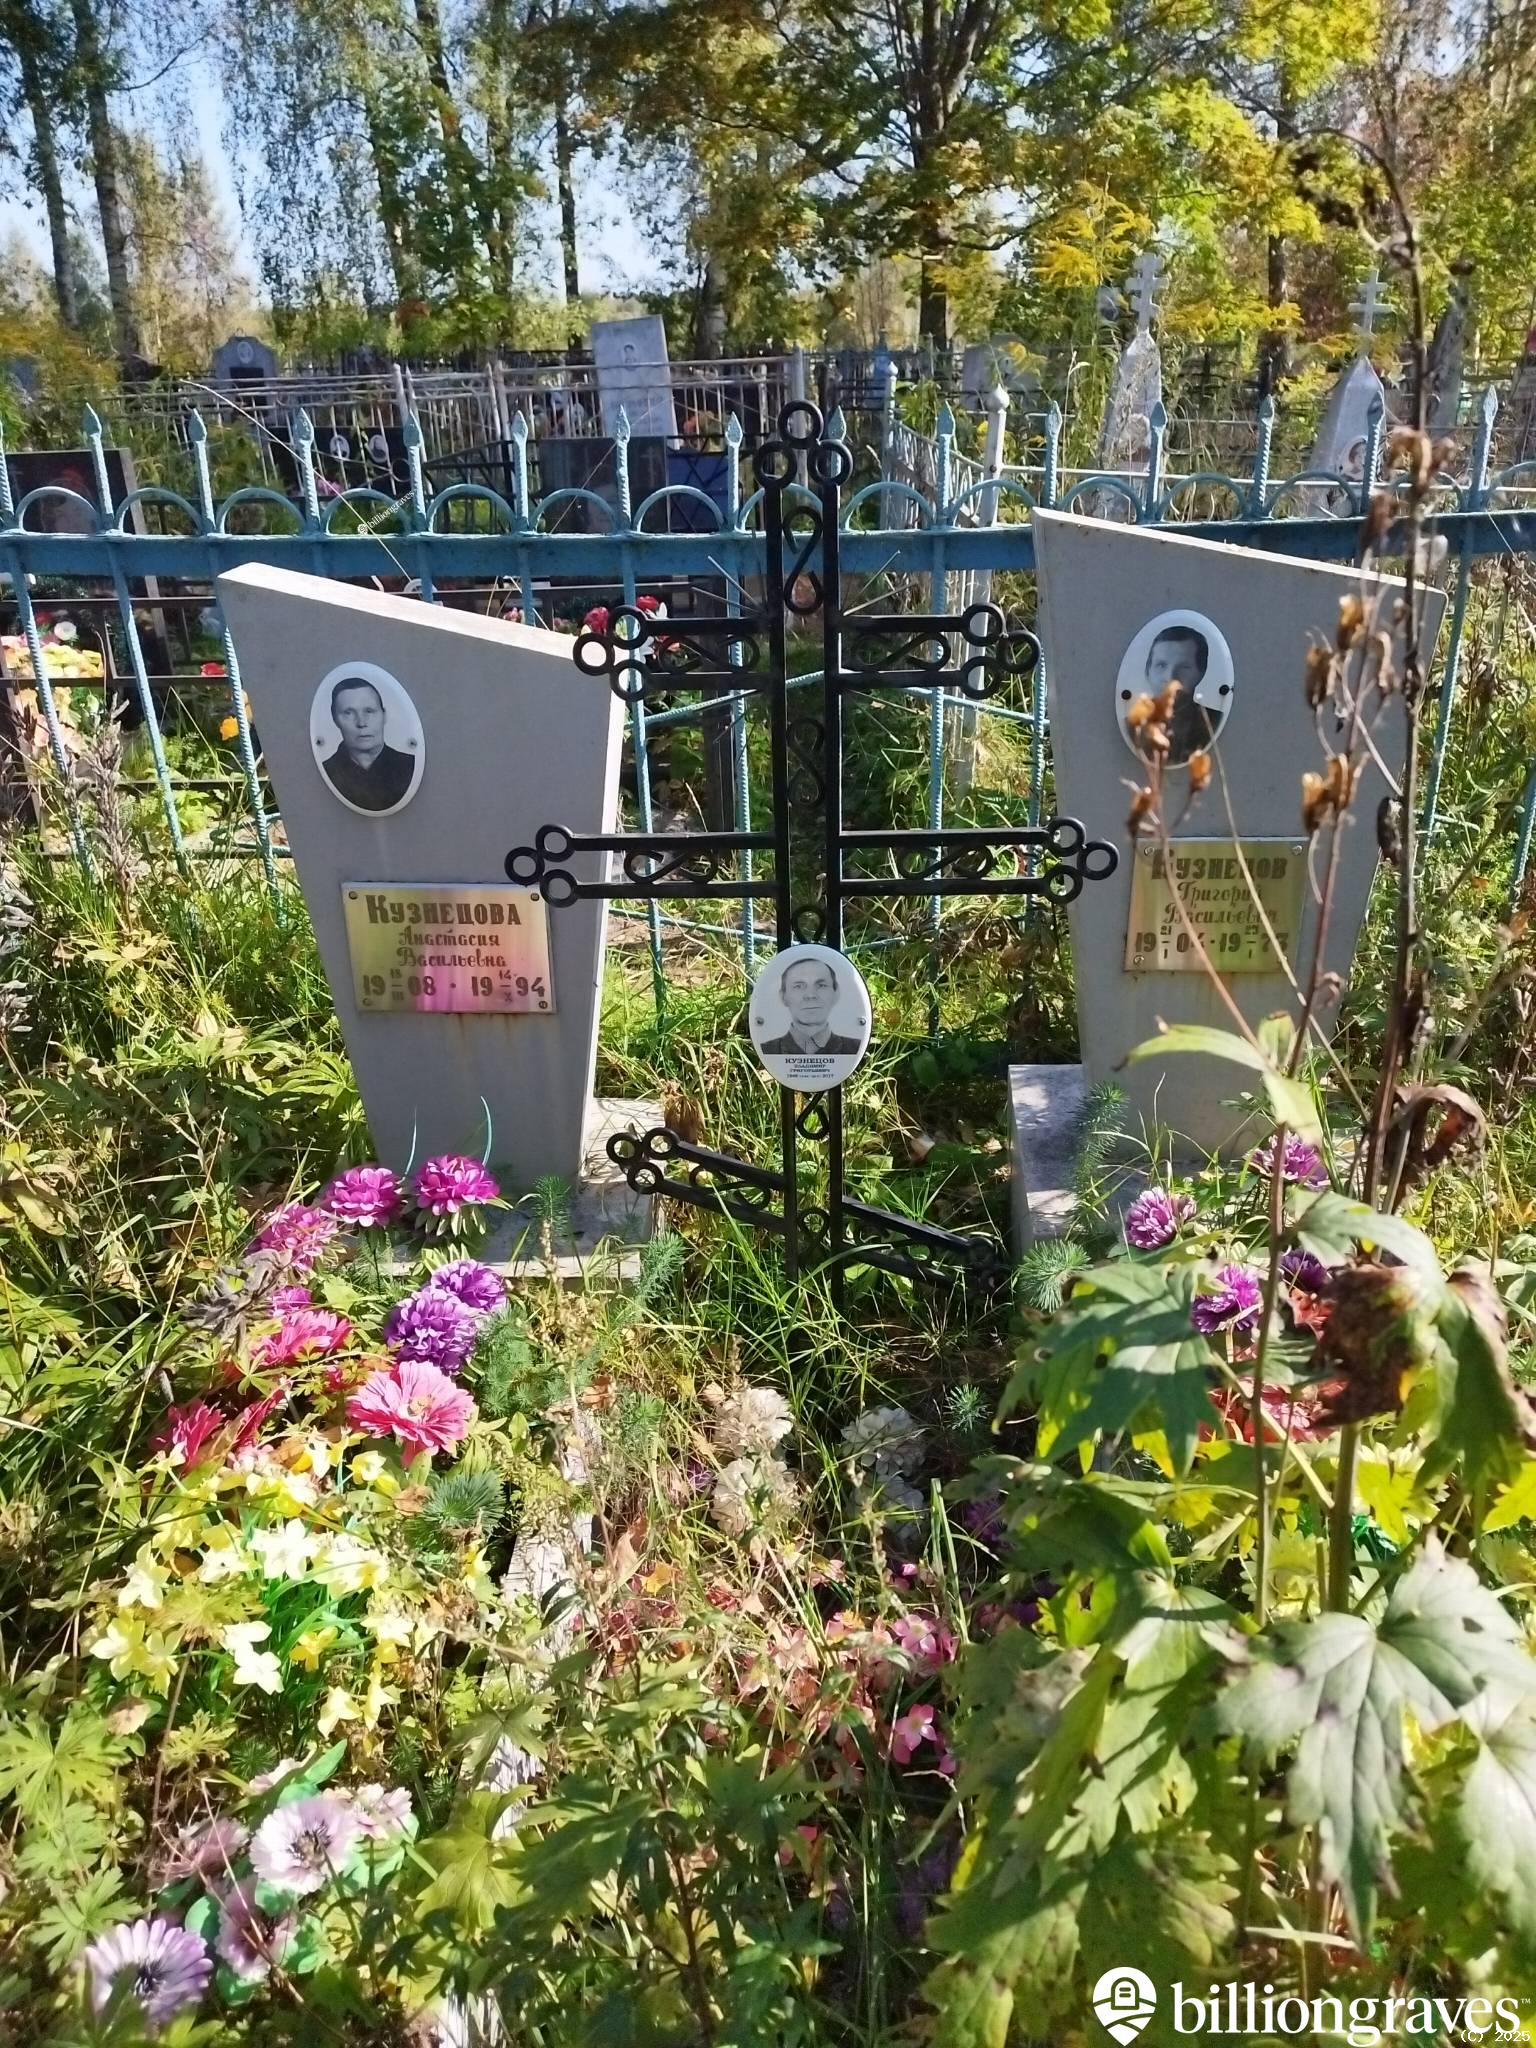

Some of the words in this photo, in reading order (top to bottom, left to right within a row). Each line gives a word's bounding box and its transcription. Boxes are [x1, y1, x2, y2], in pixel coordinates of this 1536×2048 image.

[365, 894, 521, 925] КУЗНЕЦОВА
[399, 926, 500, 946] Анастасия
[396, 947, 507, 967] Васильевна
